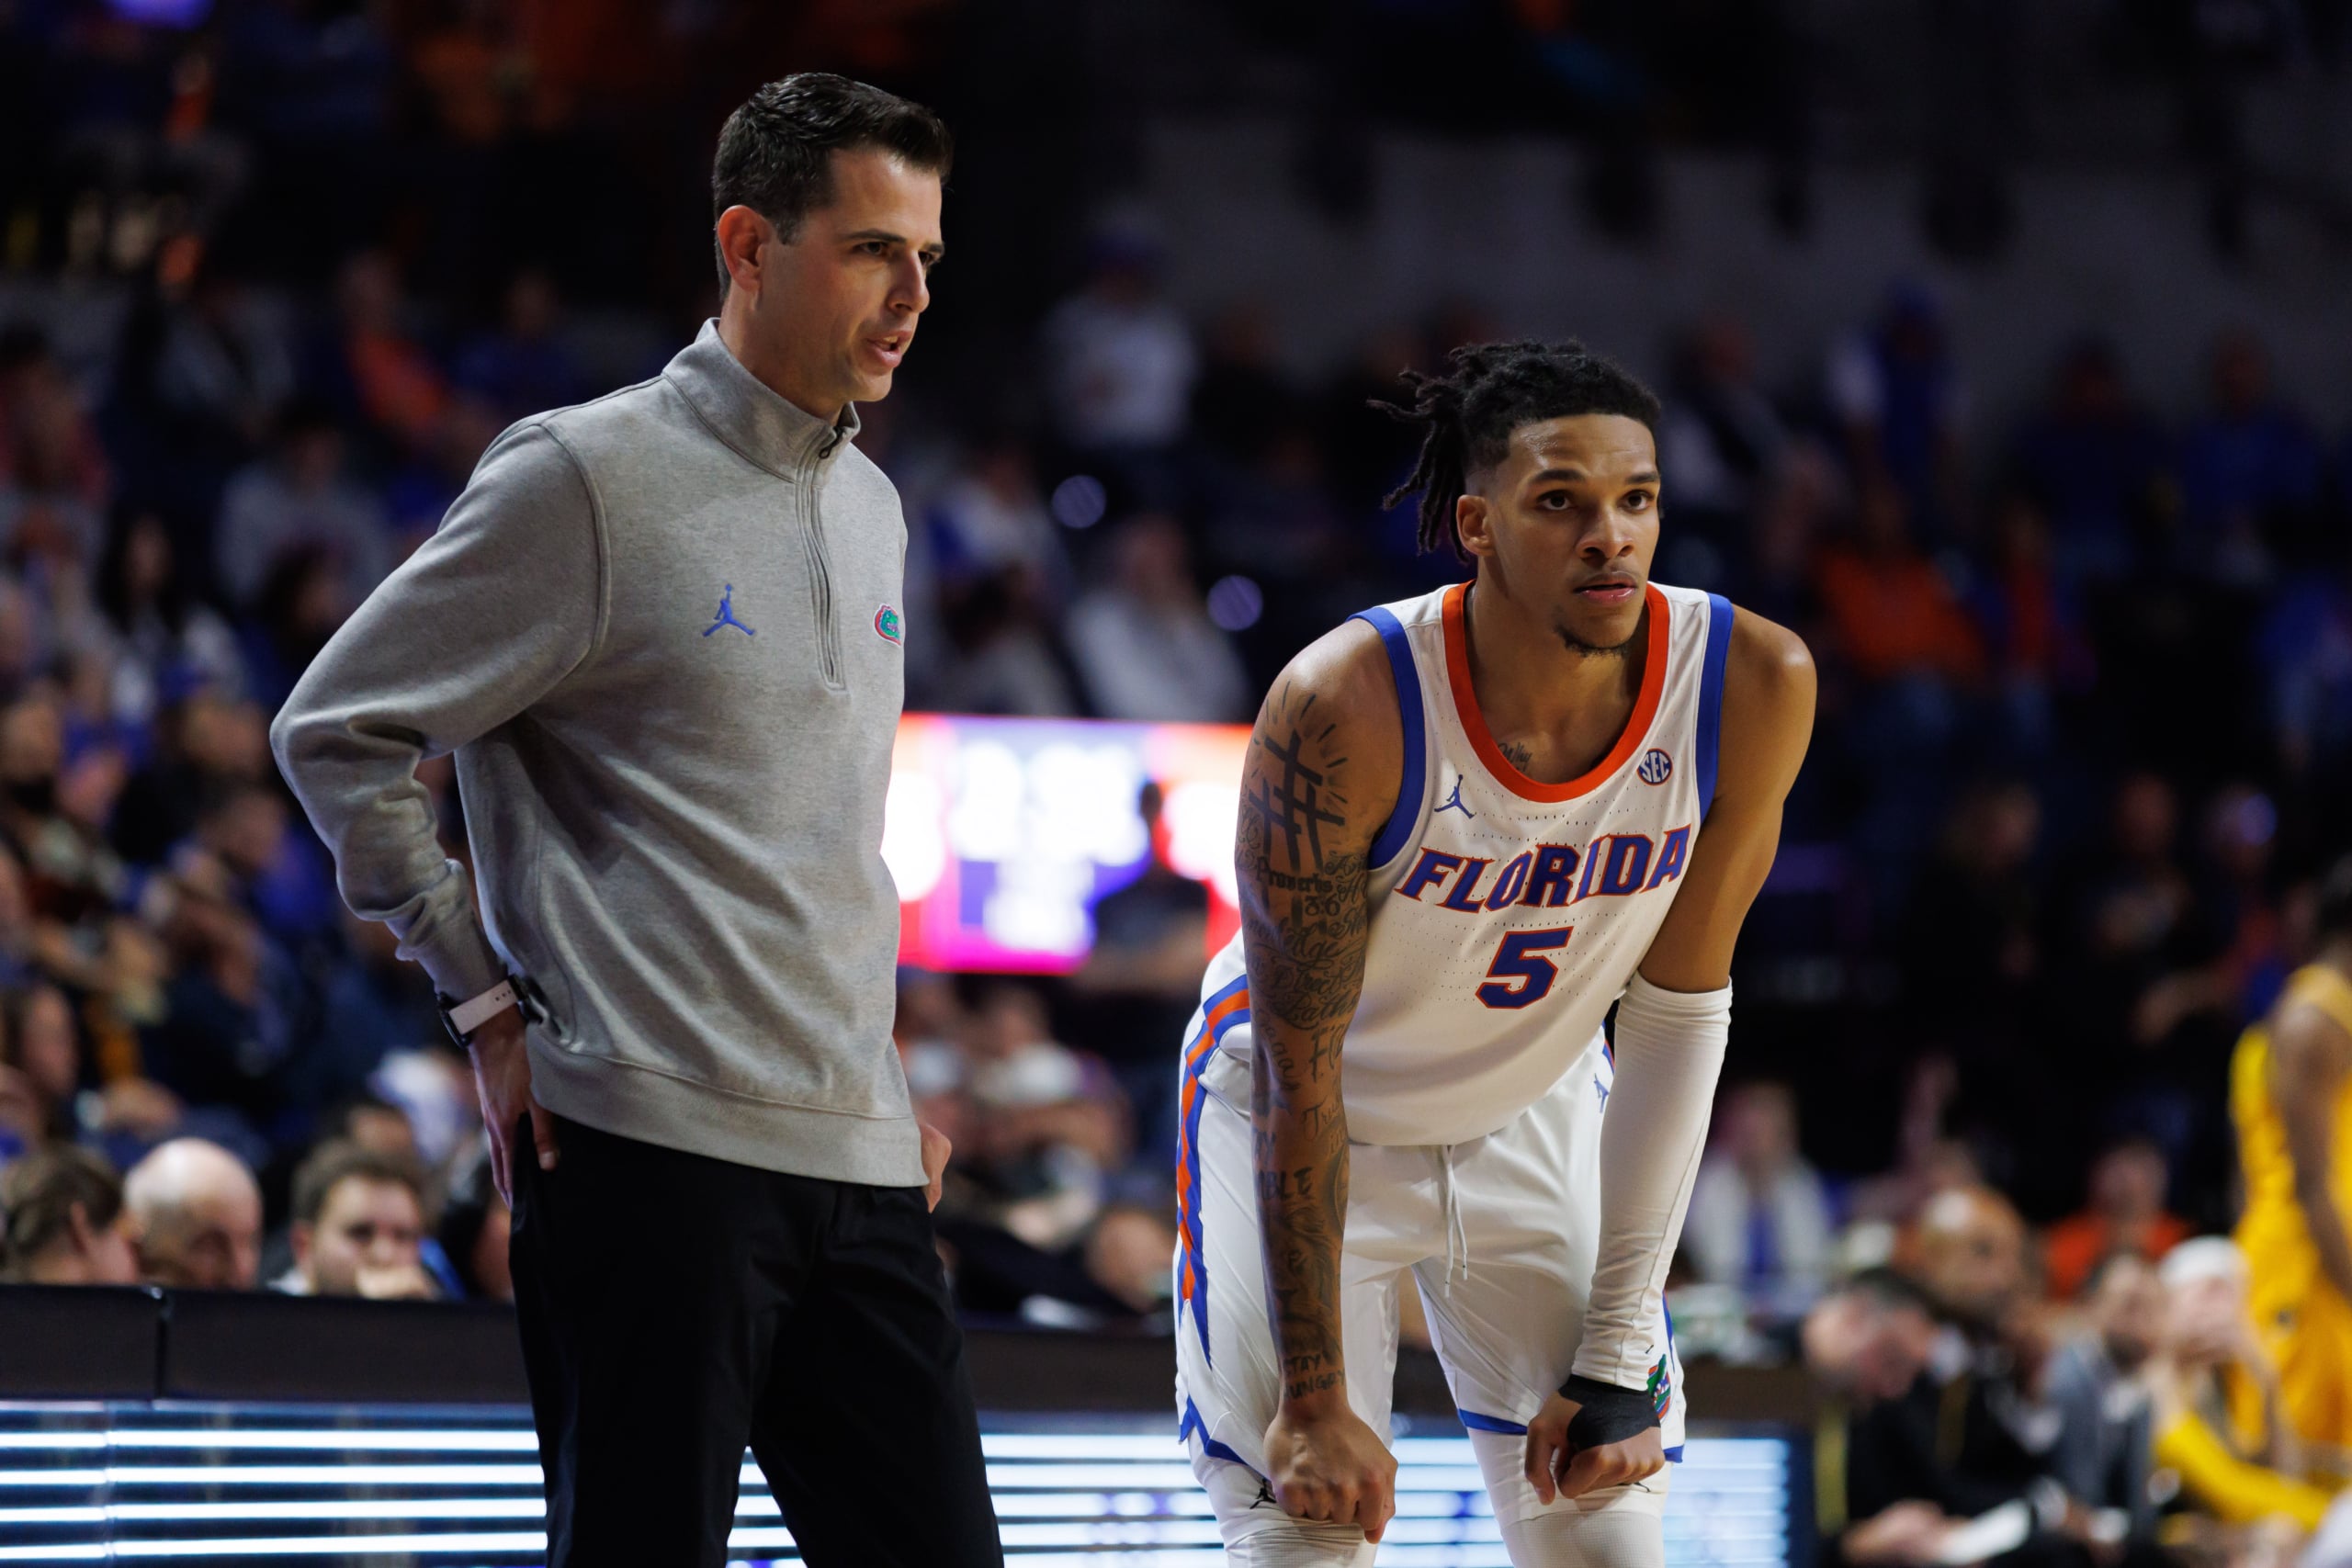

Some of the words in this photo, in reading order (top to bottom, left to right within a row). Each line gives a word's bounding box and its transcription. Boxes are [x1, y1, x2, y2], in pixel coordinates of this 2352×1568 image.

[1639, 751, 1670, 783] SEC
[1394, 824, 1691, 914] FLORIDA
[1475, 926, 1575, 1010] 5
[1286, 1368, 1345, 1400] UNGRY
